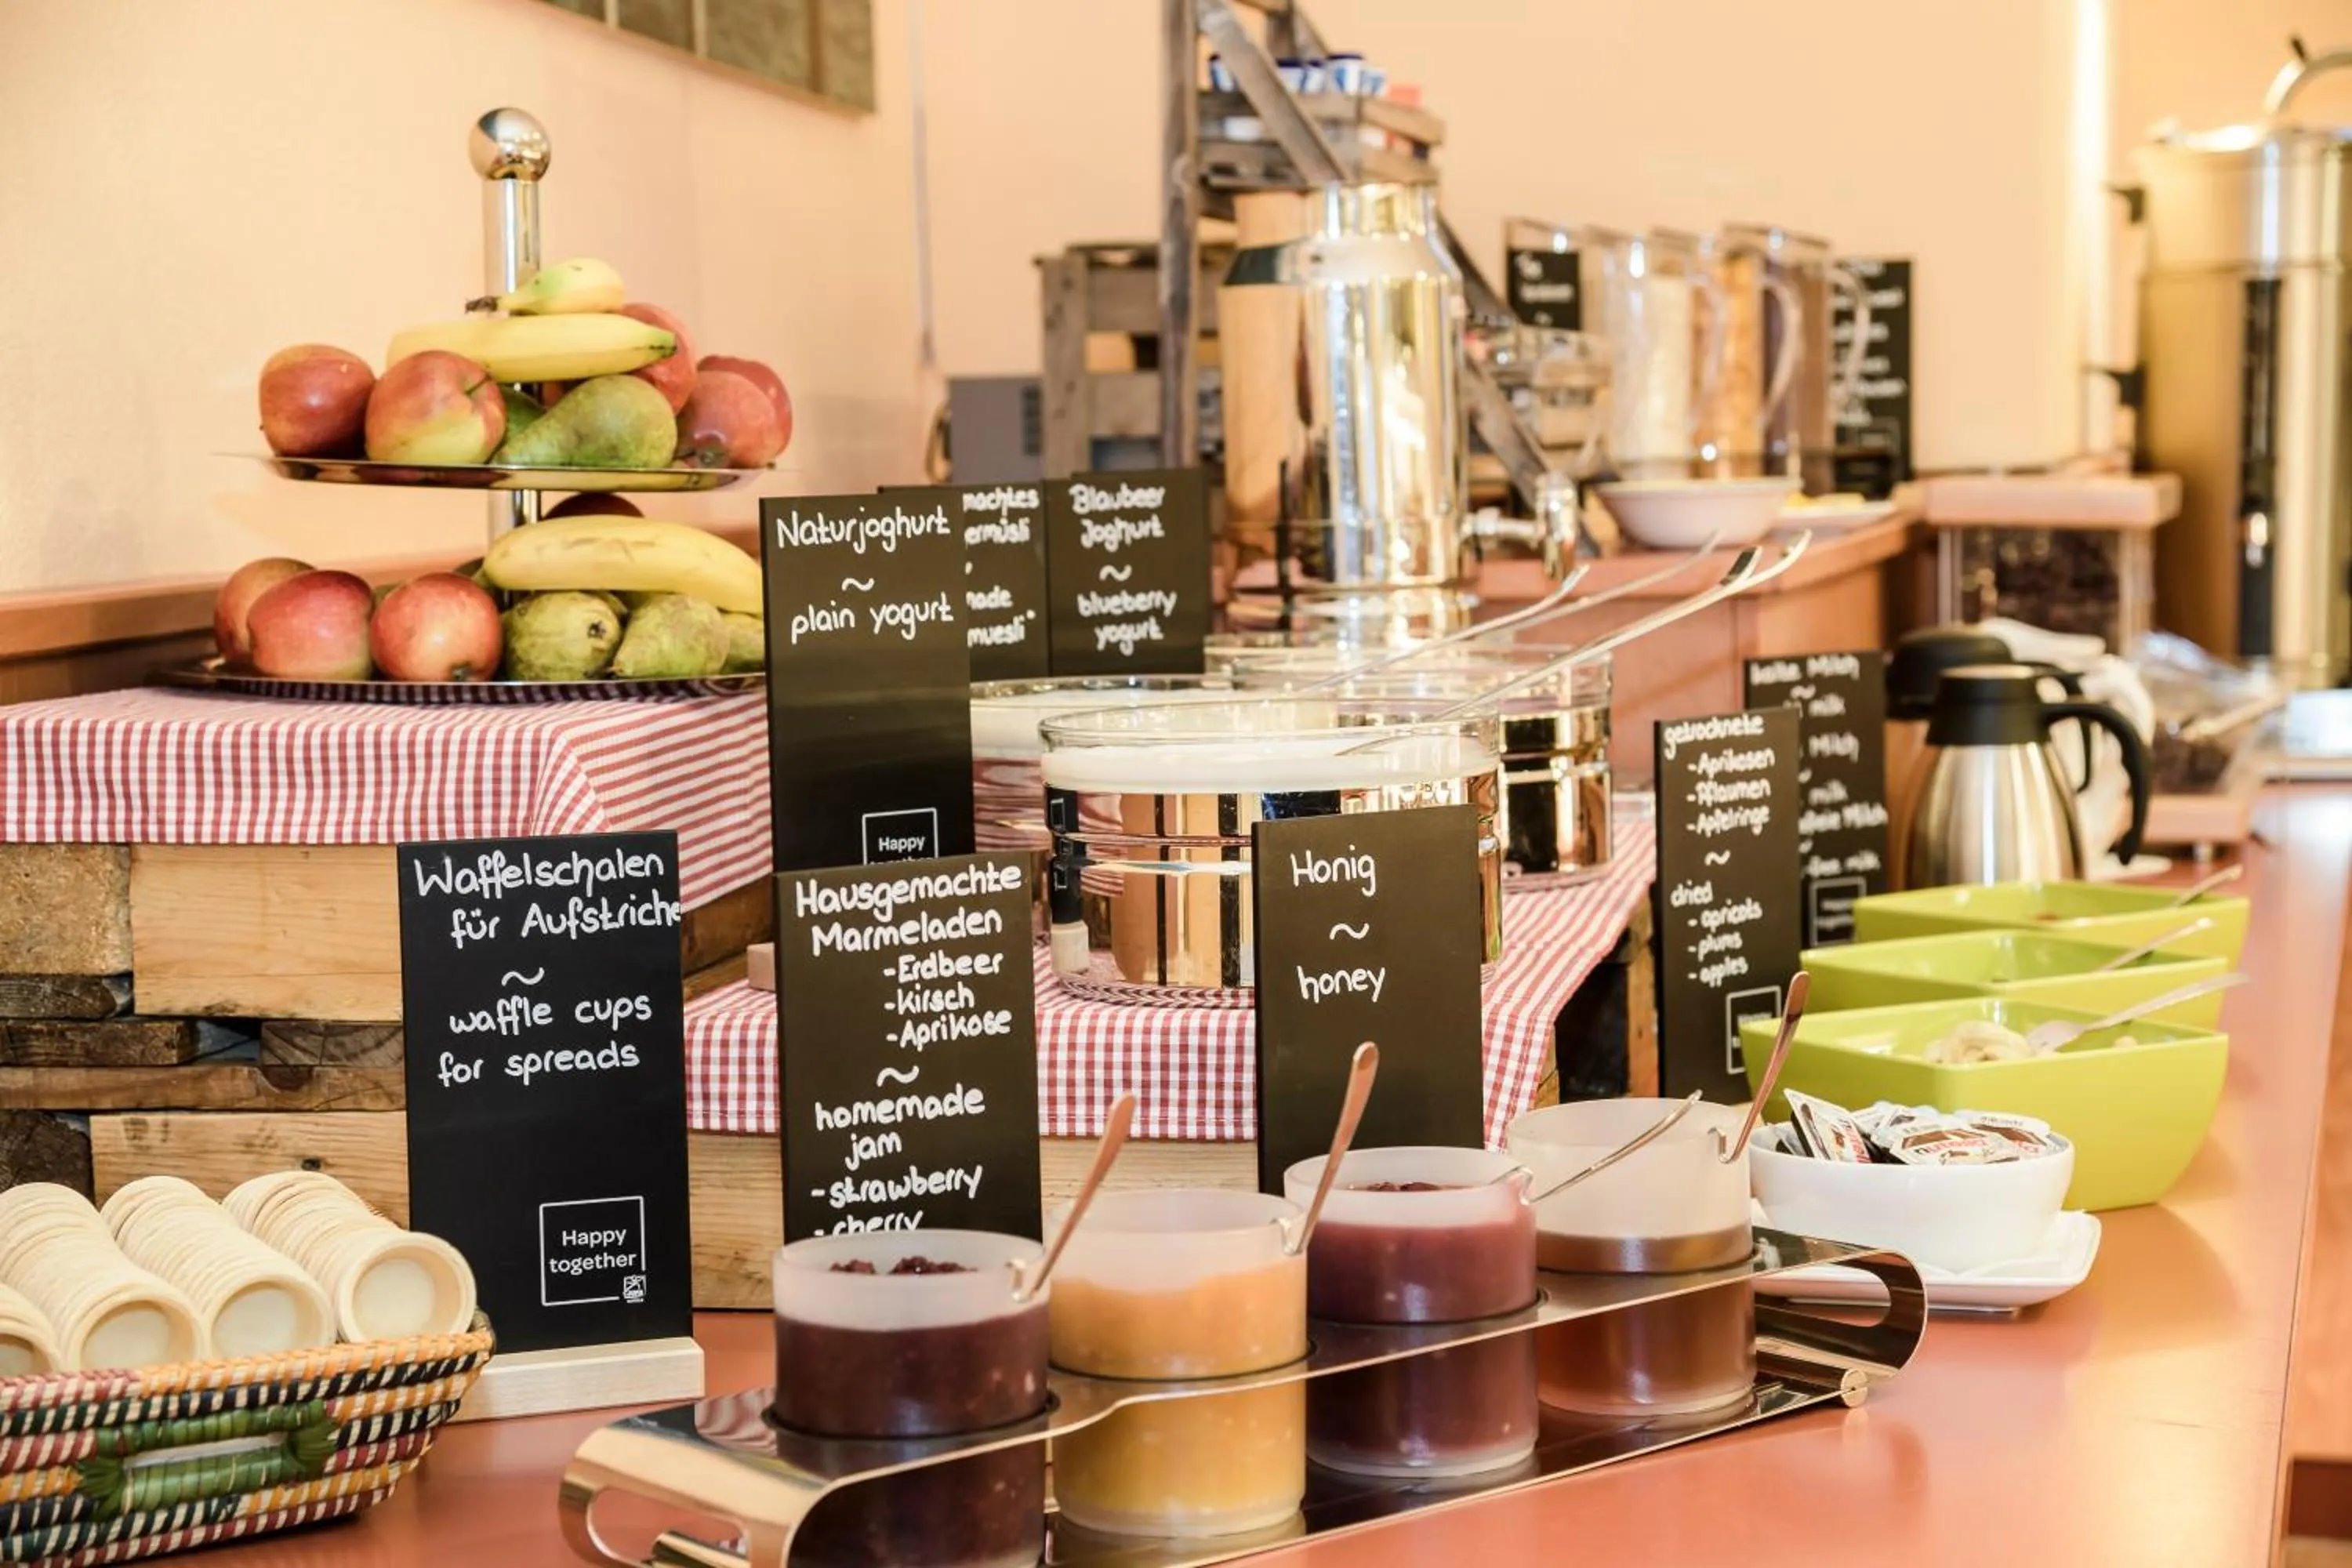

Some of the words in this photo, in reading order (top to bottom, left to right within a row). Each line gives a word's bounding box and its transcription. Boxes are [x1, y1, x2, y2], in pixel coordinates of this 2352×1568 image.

[1069, 484, 1165, 514] Blaubeer
[776, 504, 951, 555] Naturjoghurt
[1080, 515, 1164, 552] Joghurt
[790, 600, 856, 645] plain
[869, 591, 955, 641] yogurt
[1077, 590, 1177, 617] blueberry
[1095, 617, 1163, 655] yogurt
[878, 836, 926, 854] Happy
[414, 848, 665, 898] Waffelschalen
[1290, 844, 1377, 898] Honig
[795, 862, 1022, 923] Hausgemachte
[1670, 879, 1714, 907] dried
[450, 908, 501, 950] für
[520, 888, 681, 940] Aufstriche
[811, 906, 1002, 956] Marmeladen
[1296, 964, 1386, 1004] honey
[448, 994, 554, 1036] waffle
[574, 994, 652, 1032] cups
[437, 1051, 485, 1088] for
[504, 1040, 641, 1087] spreads
[814, 1082, 985, 1131] homemade
[844, 1131, 902, 1171] jam
[561, 1228, 627, 1249] Happy
[549, 1251, 638, 1276] together
